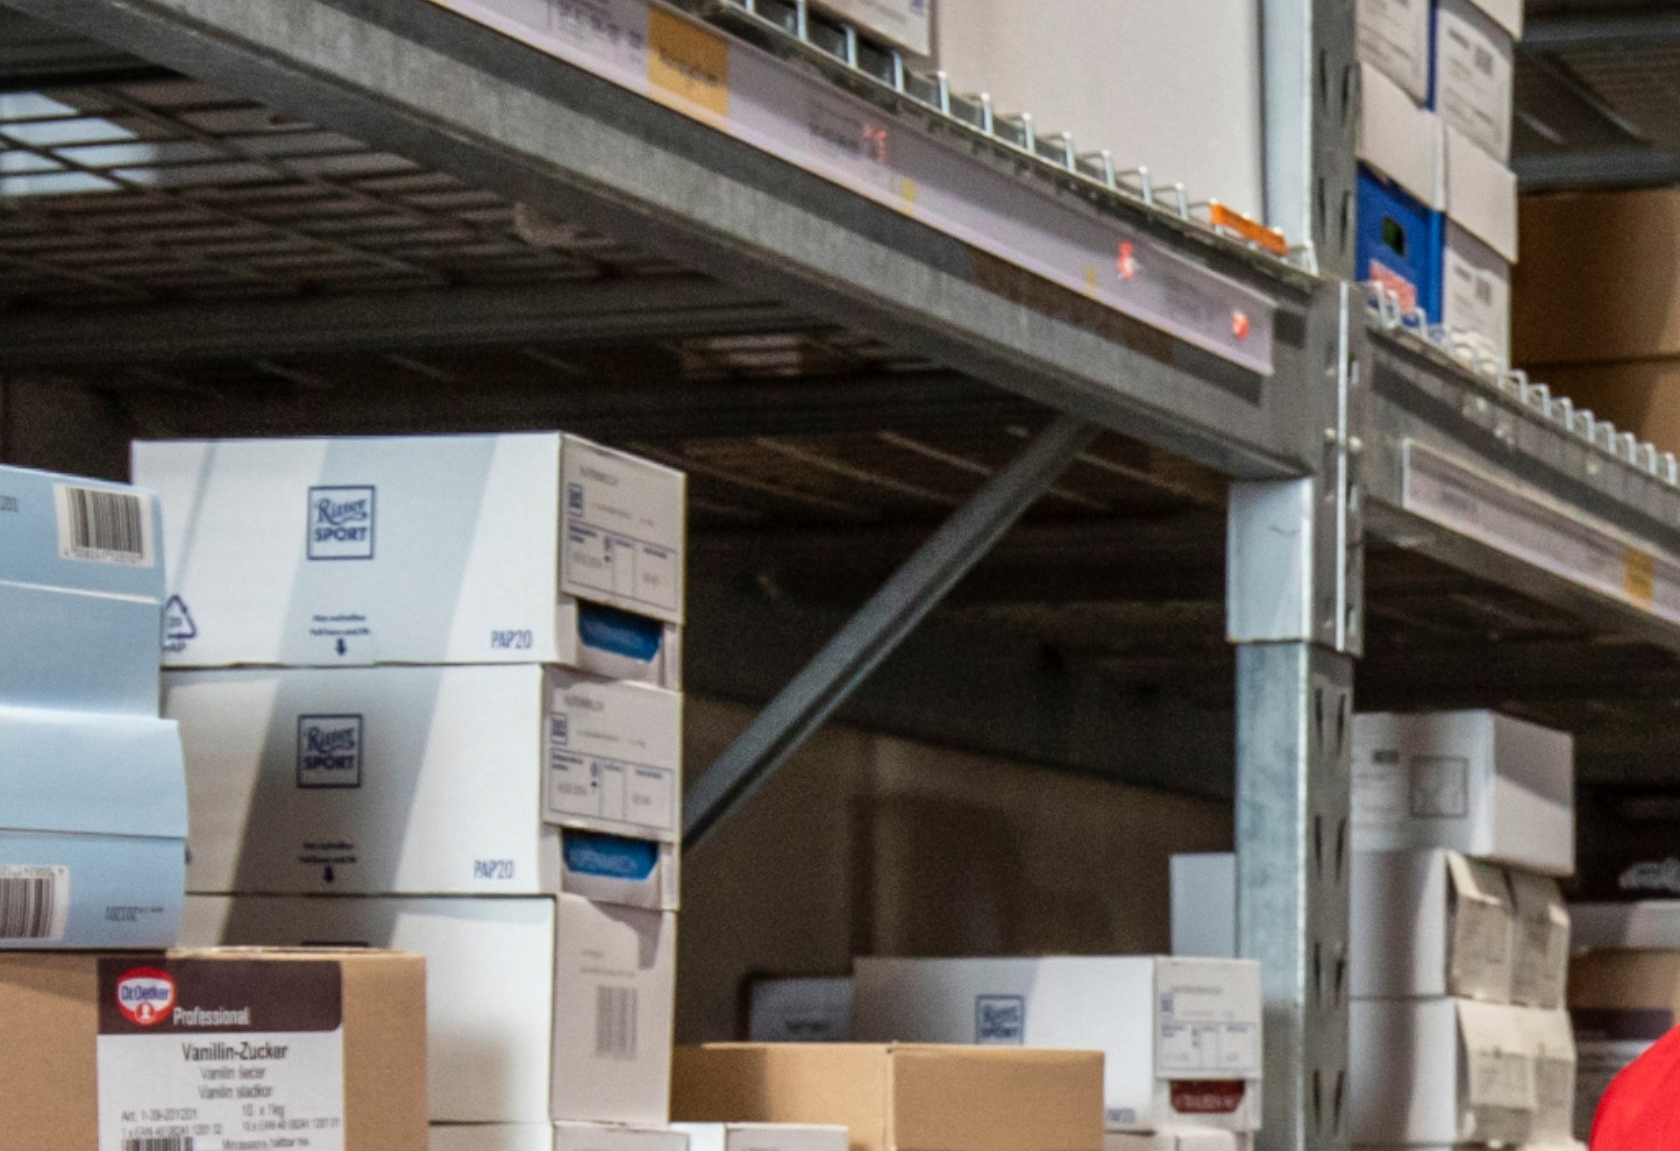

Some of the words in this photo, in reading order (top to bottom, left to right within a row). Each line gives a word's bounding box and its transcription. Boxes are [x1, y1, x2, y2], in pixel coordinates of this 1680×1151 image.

[314, 526, 368, 542] SPORT
[304, 755, 355, 770] SPORT
[173, 1005, 251, 1026] Professional
[181, 1041, 288, 1062] Vanillin-Zucker
